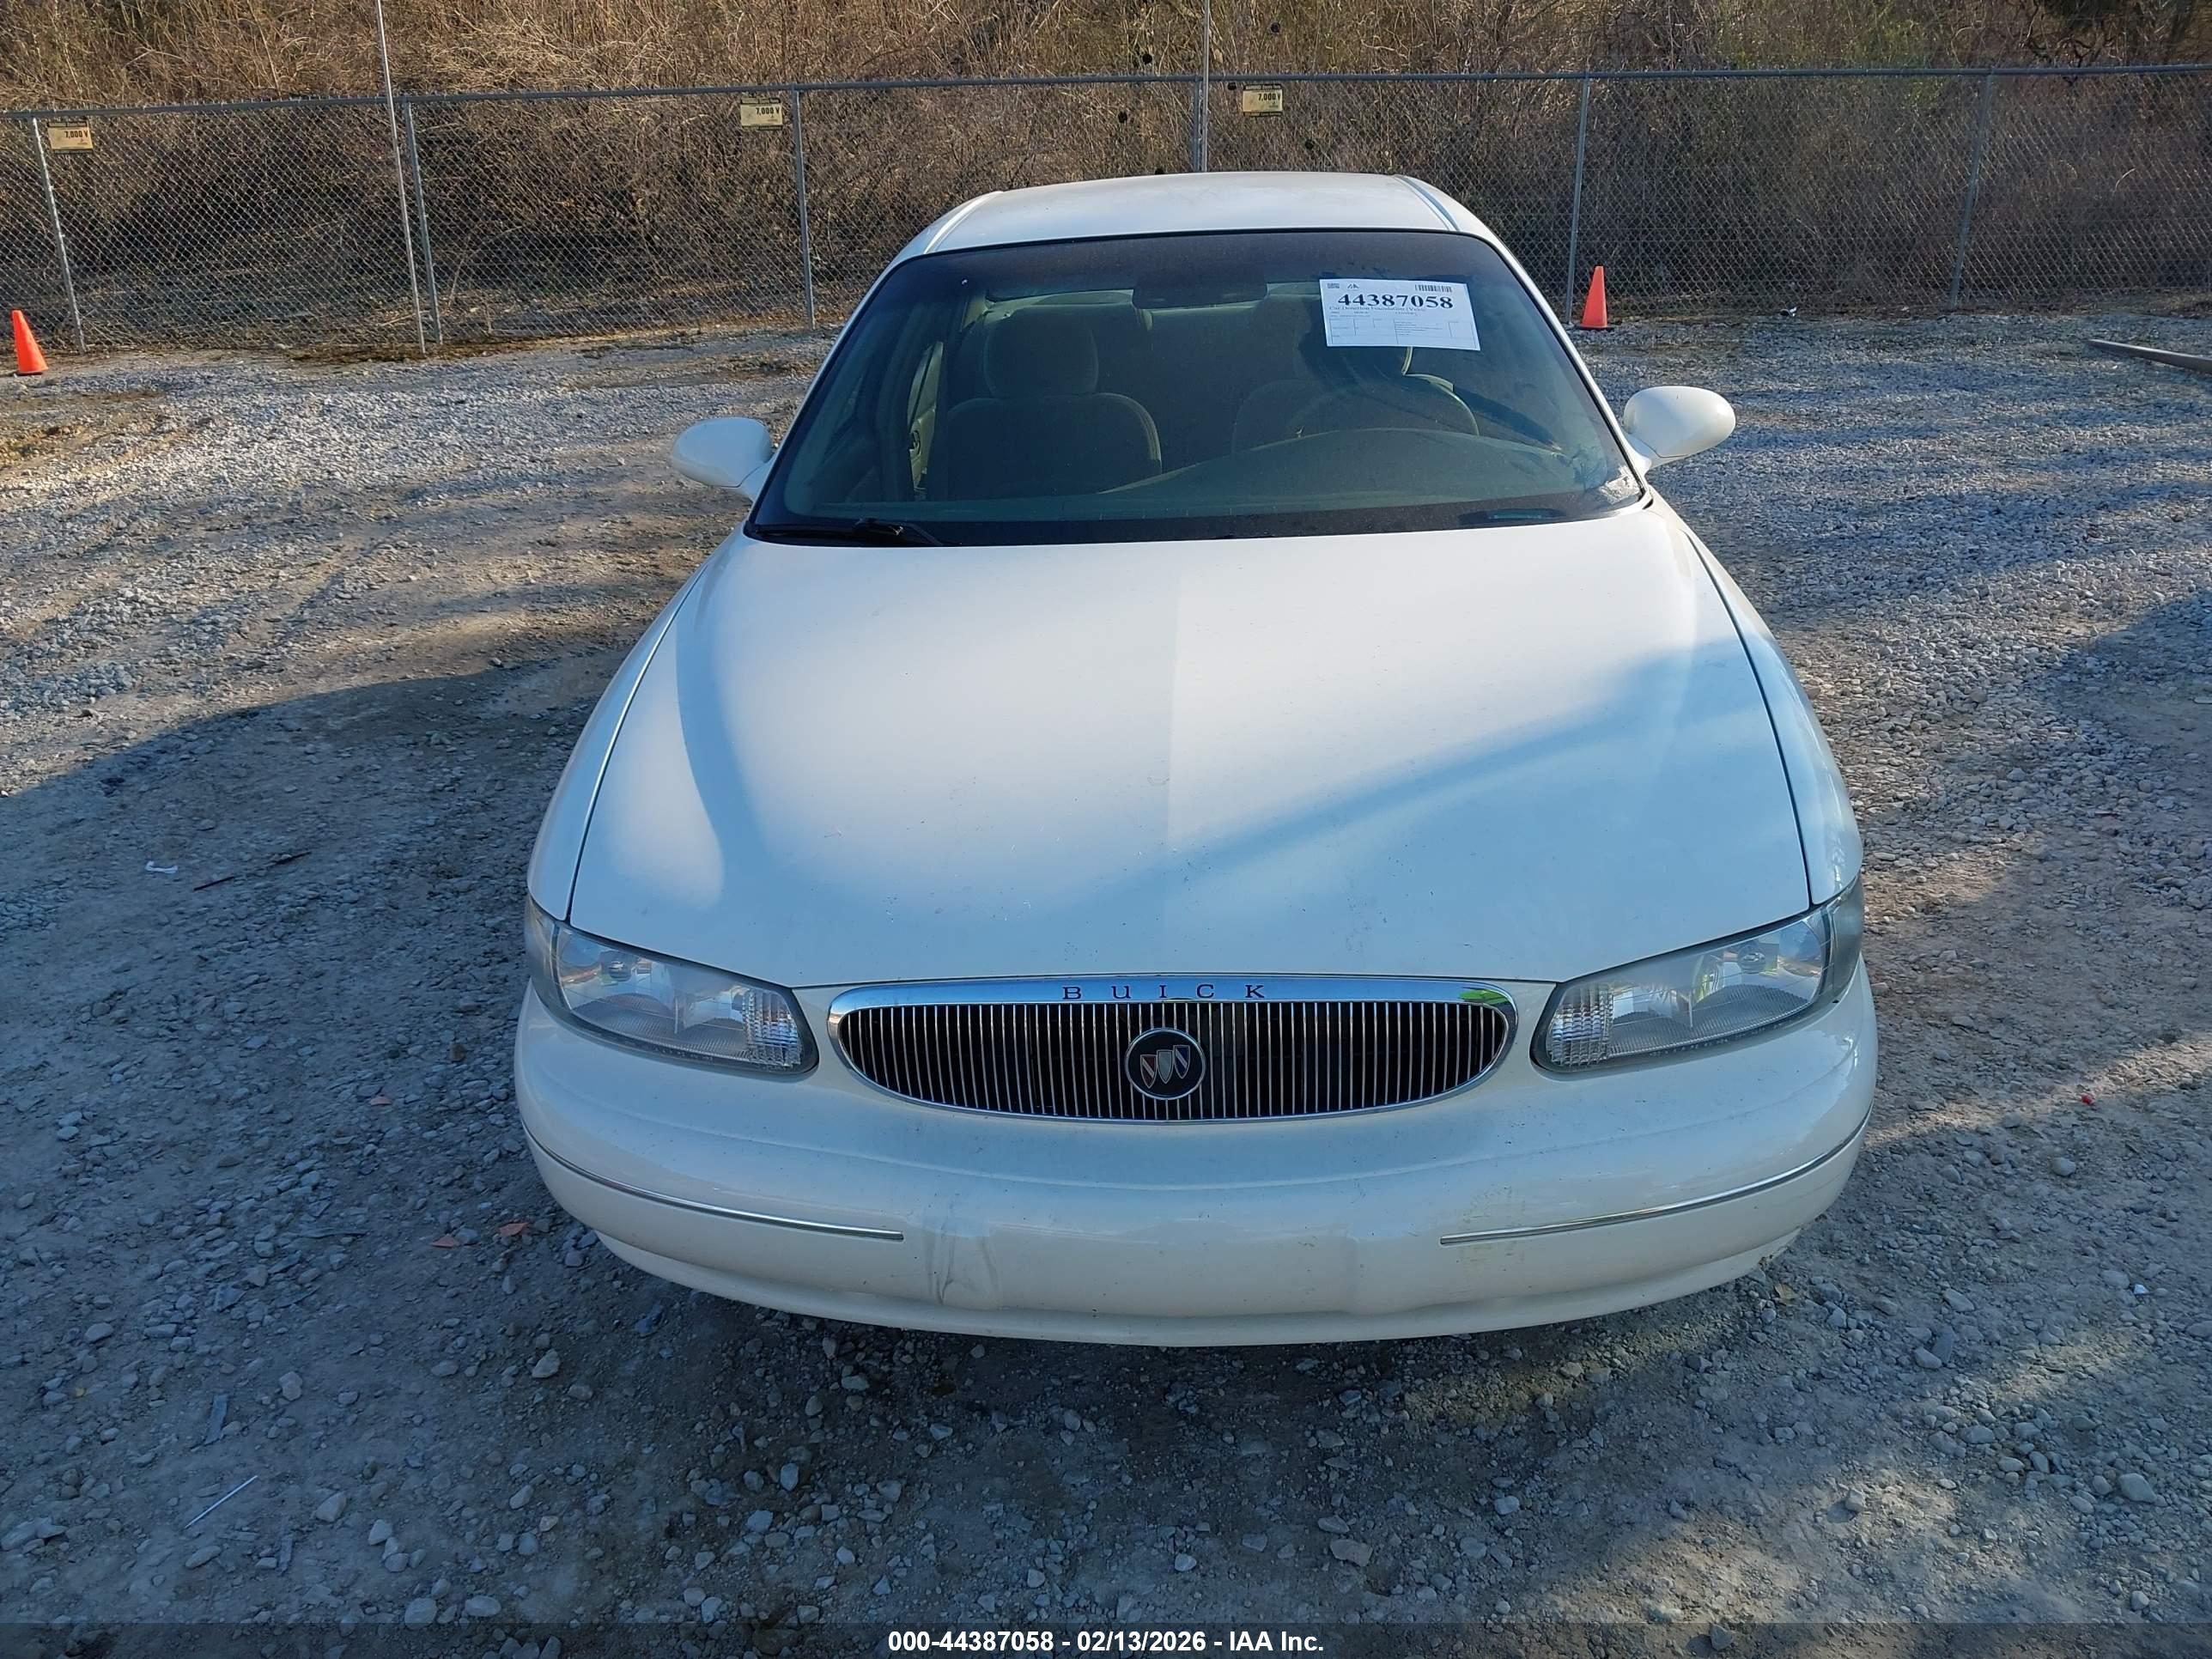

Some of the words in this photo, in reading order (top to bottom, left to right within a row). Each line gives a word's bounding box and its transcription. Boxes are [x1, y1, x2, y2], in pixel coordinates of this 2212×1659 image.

[1258, 93, 1276, 101] 7,000
[756, 106, 774, 116] 7,000
[64, 130, 83, 139] 7,000
[1338, 294, 1453, 309] 44387058
[1061, 983, 1266, 1000] BUICK
